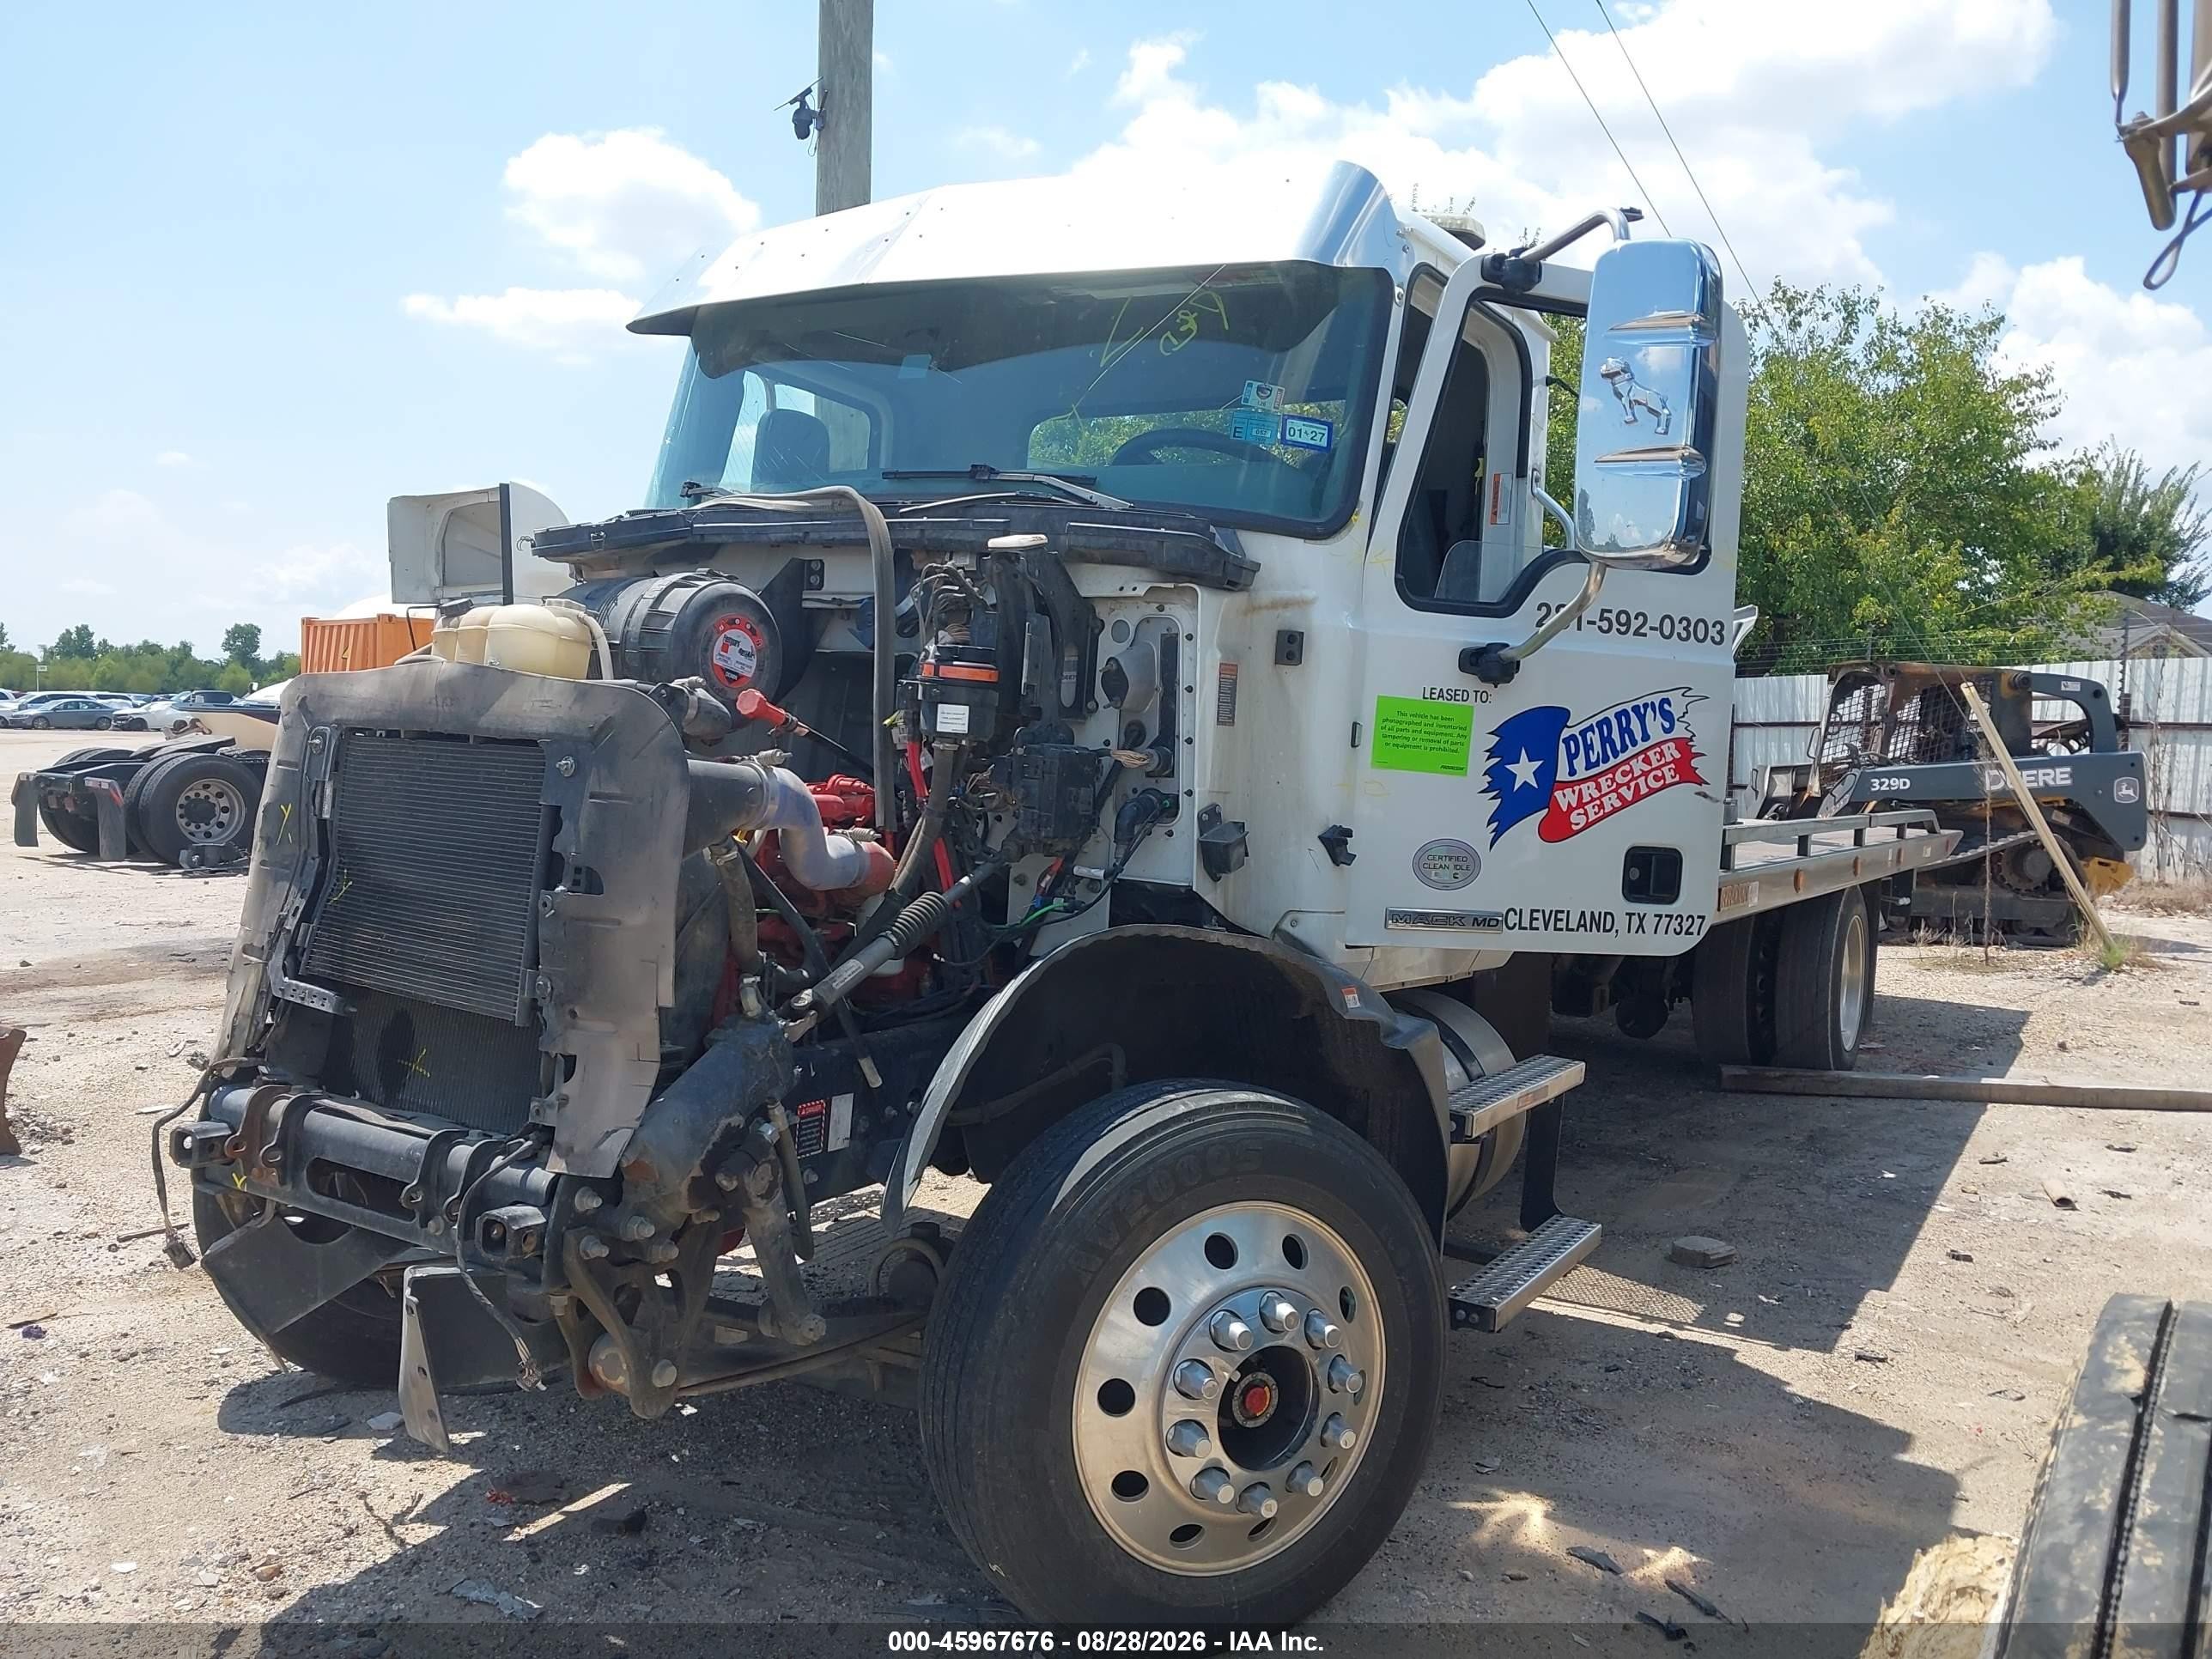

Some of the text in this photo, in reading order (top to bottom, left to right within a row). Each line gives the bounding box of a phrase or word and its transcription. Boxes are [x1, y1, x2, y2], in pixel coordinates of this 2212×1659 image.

[1233, 426, 1243, 438] E
[1422, 686, 1492, 704] LEASED TO:
[1382, 717, 1422, 726] photographed
[1382, 733, 1410, 742] tampering
[1562, 697, 1675, 777] PERRY'S
[1554, 741, 1681, 812] WRECKER
[1870, 778, 1911, 792] 329D
[1570, 763, 1680, 830] SERVICE
[1426, 854, 1468, 863] CERTIFIED
[1422, 862, 1450, 871] CLEAN
[1391, 914, 1500, 927] MACK MD
[1504, 907, 1706, 939] CLEVELAND, TX 77327
